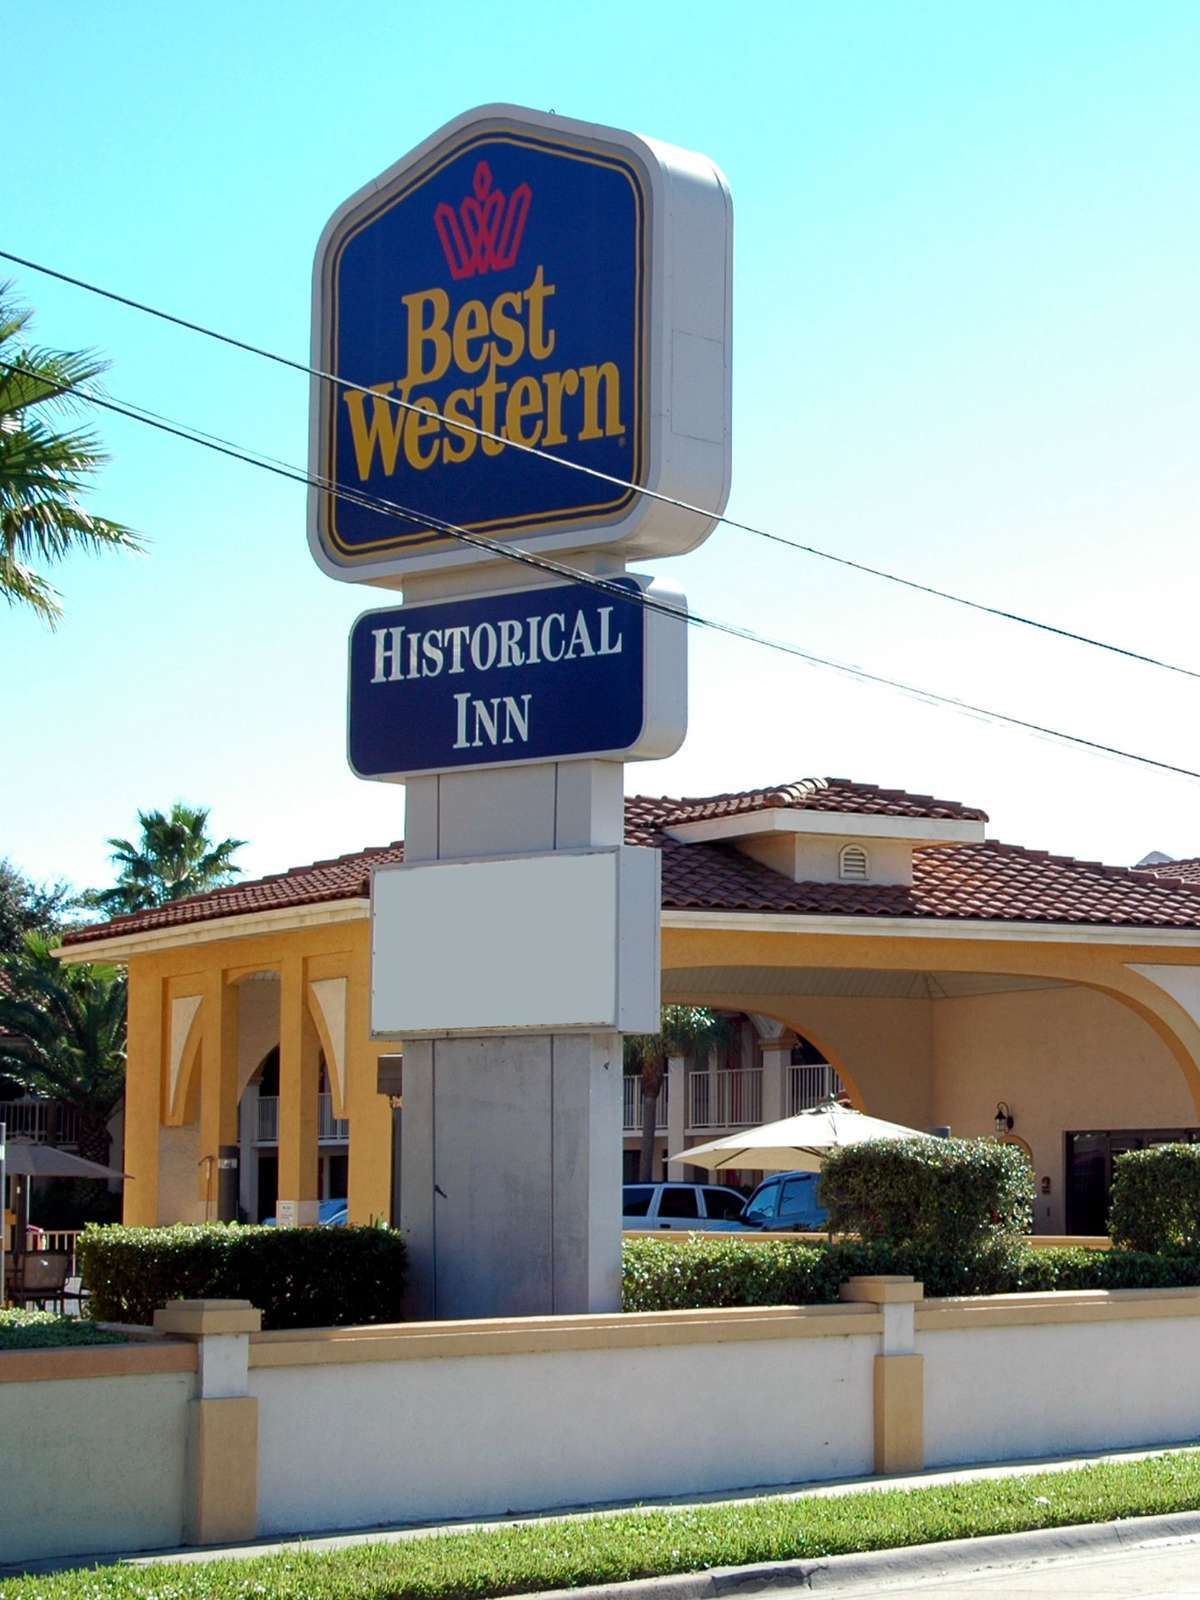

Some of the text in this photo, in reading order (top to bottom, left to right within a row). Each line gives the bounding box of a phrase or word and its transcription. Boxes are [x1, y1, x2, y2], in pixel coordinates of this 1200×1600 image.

[402, 265, 555, 385] Best
[343, 361, 625, 482] Western
[370, 607, 623, 684] HISTORICAL
[453, 693, 533, 749] INN
